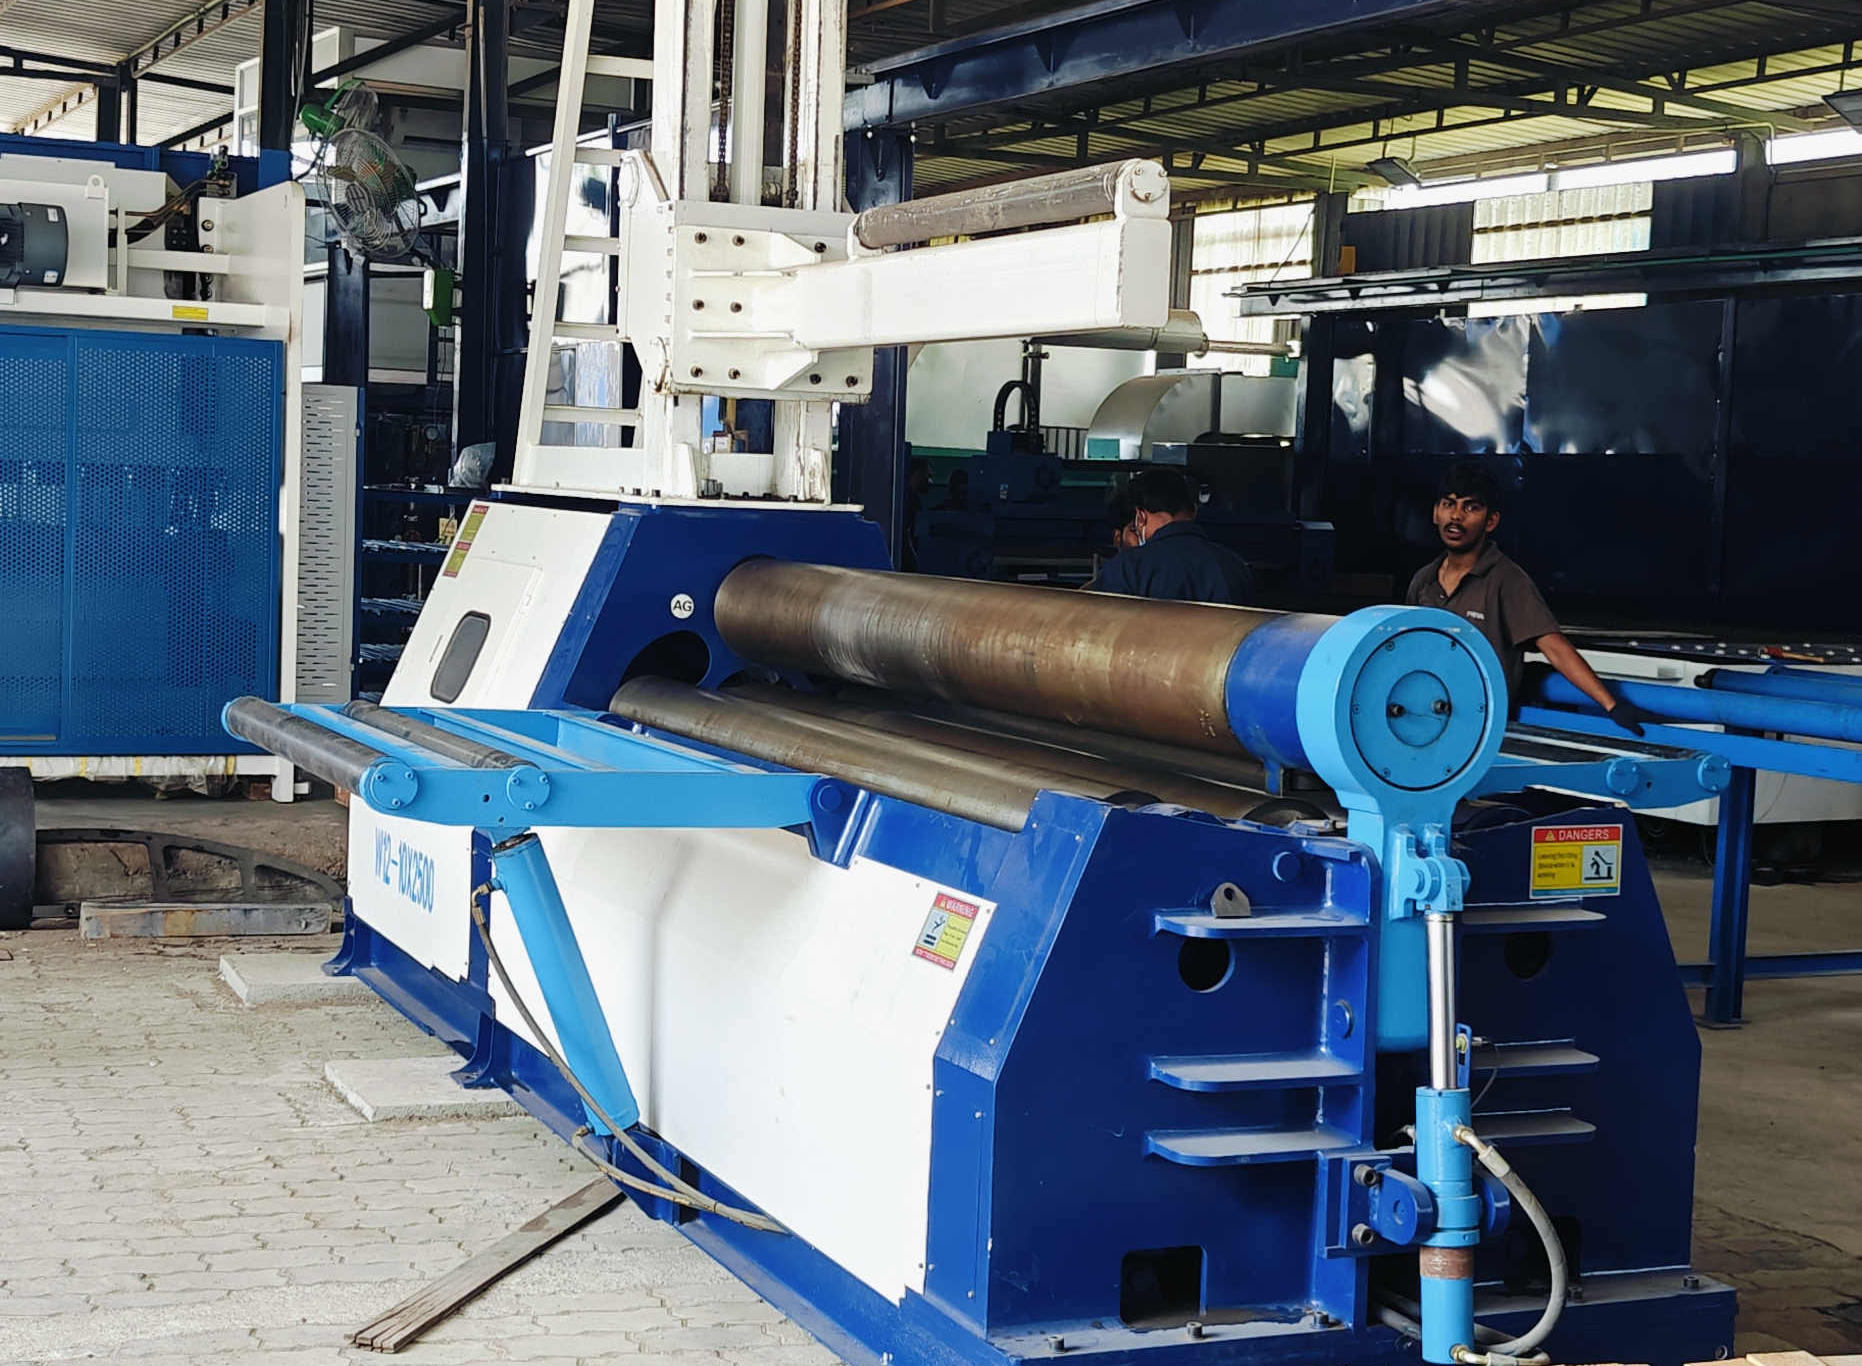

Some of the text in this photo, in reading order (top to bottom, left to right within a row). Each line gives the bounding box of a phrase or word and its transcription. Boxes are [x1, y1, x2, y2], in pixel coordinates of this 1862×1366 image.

[672, 599, 693, 612] AG
[1558, 829, 1610, 841] DANGERS
[374, 825, 435, 914] W12-10X2500
